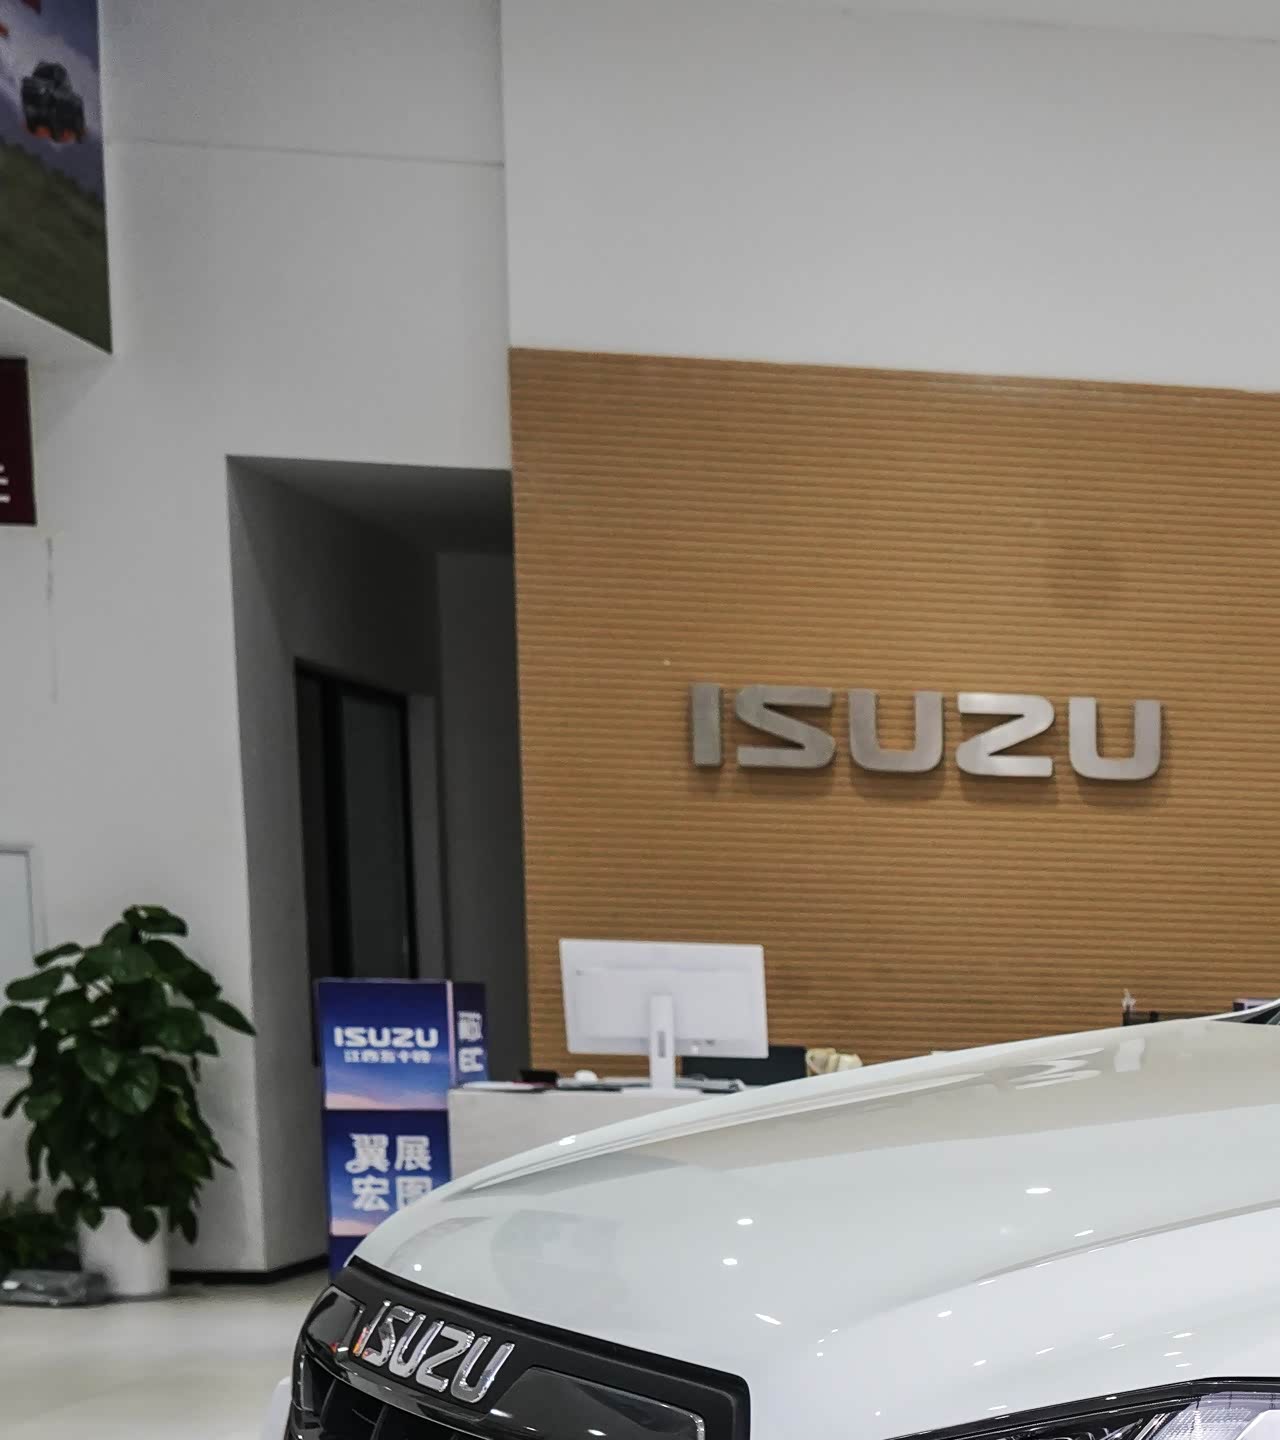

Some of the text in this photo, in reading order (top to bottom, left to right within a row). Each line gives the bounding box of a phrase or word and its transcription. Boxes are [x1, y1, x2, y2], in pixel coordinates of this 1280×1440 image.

[690, 683, 1162, 782] ISUZU
[334, 1026, 439, 1048] ISUZU
[345, 1133, 432, 1174] 翼展
[353, 1300, 516, 1404] ISUZU
